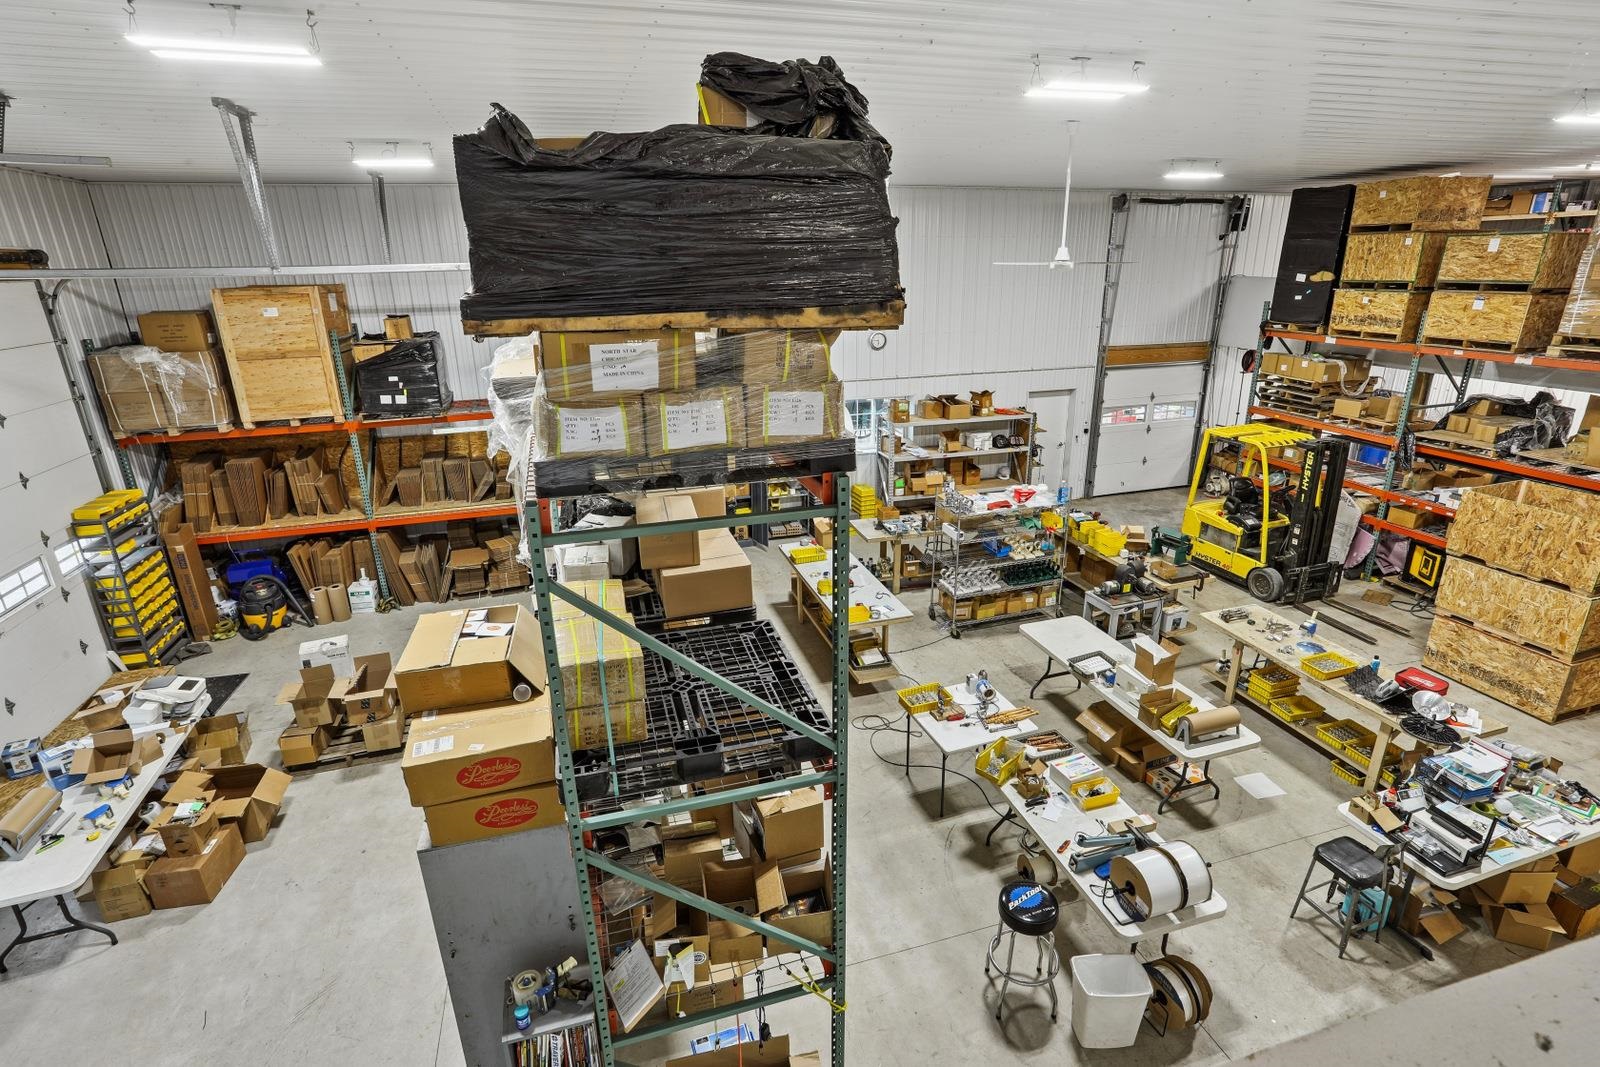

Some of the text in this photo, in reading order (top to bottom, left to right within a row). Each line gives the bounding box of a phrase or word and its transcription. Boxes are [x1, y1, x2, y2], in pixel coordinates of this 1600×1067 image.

[1302, 451, 1315, 490] HYSTER
[1195, 551, 1222, 567] HYSTER
[462, 759, 520, 785] Peerless
[479, 801, 538, 824] Peerless
